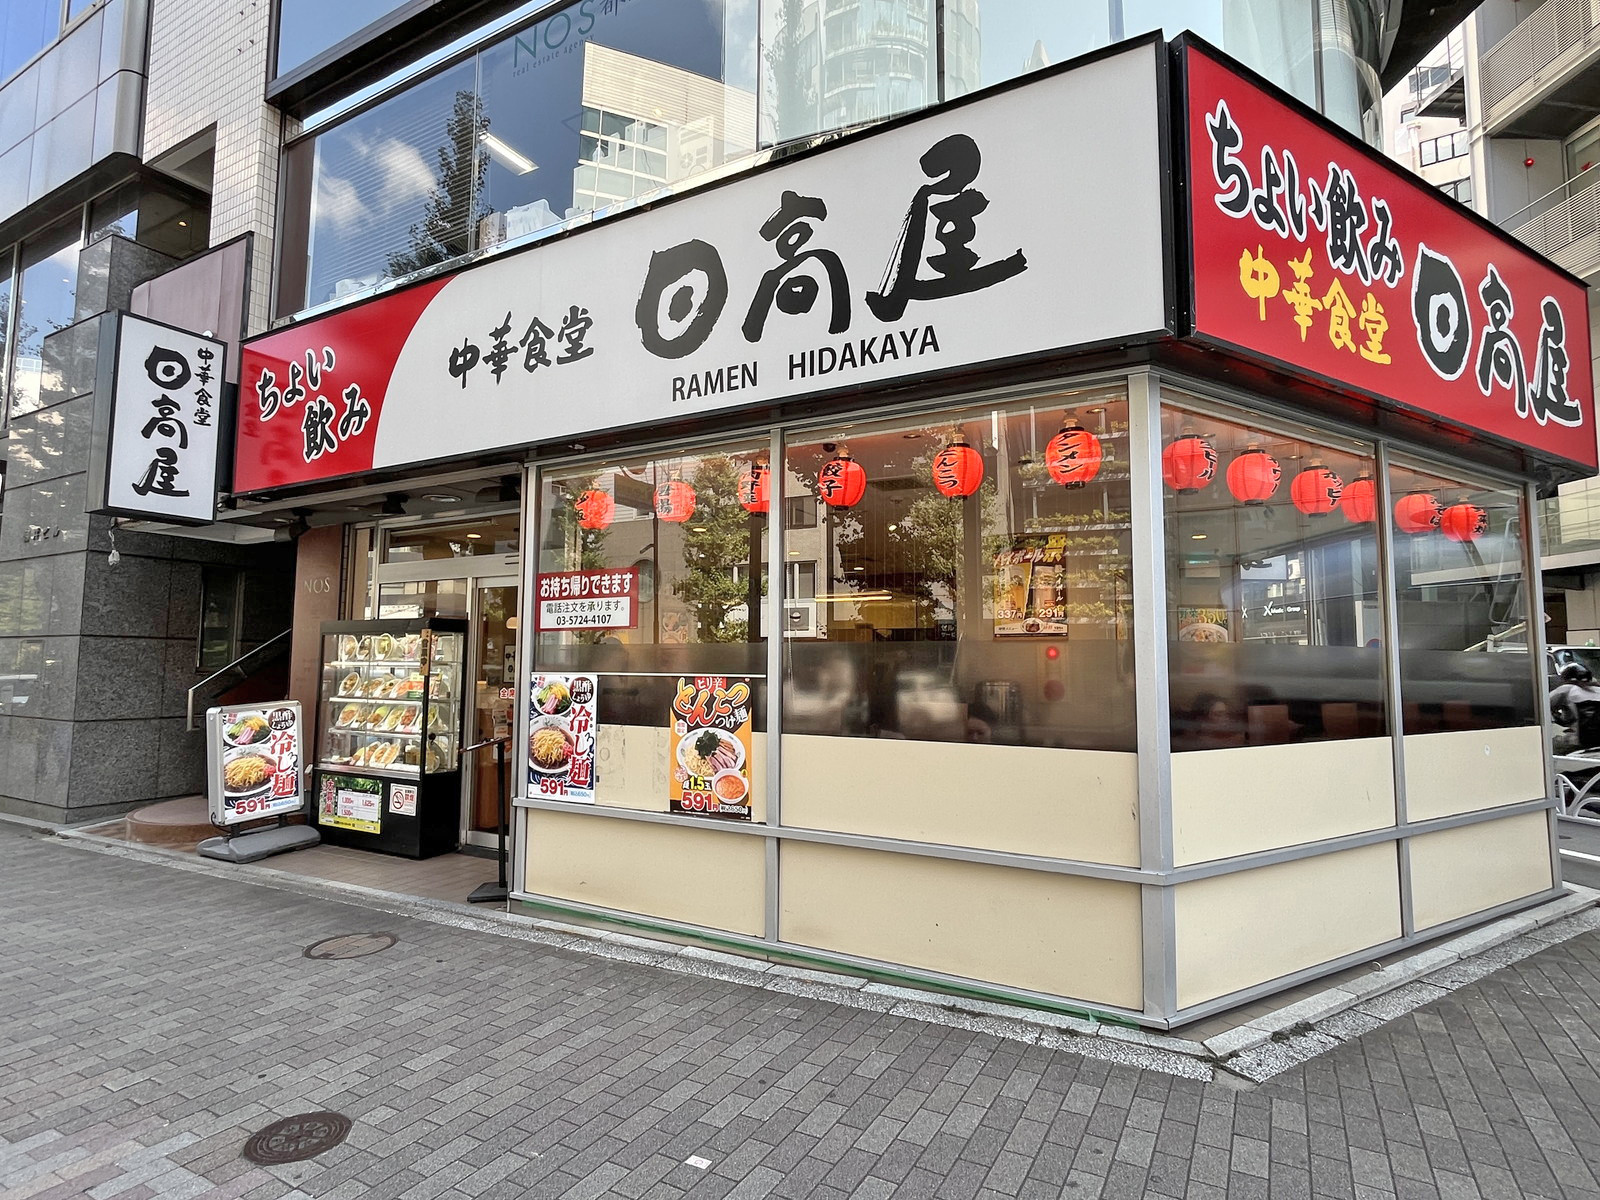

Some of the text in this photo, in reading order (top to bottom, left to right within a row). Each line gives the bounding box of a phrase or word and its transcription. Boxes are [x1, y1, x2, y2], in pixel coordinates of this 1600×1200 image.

[512, 63, 530, 77] real
[532, 50, 560, 68] estate
[513, 0, 595, 68] NOS
[1206, 99, 1405, 289] ちょい飲み
[636, 134, 1027, 358] 日高屋
[1239, 245, 1392, 365] 中華食堂
[1411, 242, 1583, 427] 日高屋
[448, 305, 594, 389] 中華食堂
[671, 324, 940, 401] RAMEN HIDAKAYA
[193, 347, 216, 427] 中華食堂
[256, 346, 336, 422] ちょい
[131, 345, 192, 497] 日高屋
[301, 383, 371, 463] 飲み
[303, 576, 331, 594] NOS
[539, 571, 633, 598] お持ち帰りできます
[546, 599, 625, 614] 電話注文を承ります。
[556, 614, 612, 626] 03-5724-4107
[673, 677, 750, 727] とんこつ
[714, 705, 749, 730] つけ麺
[270, 730, 296, 797] 冷し麺
[569, 705, 593, 786] 冷し麺
[235, 796, 271, 815] 591円
[540, 778, 569, 796] 591円
[681, 791, 719, 811] 591円
